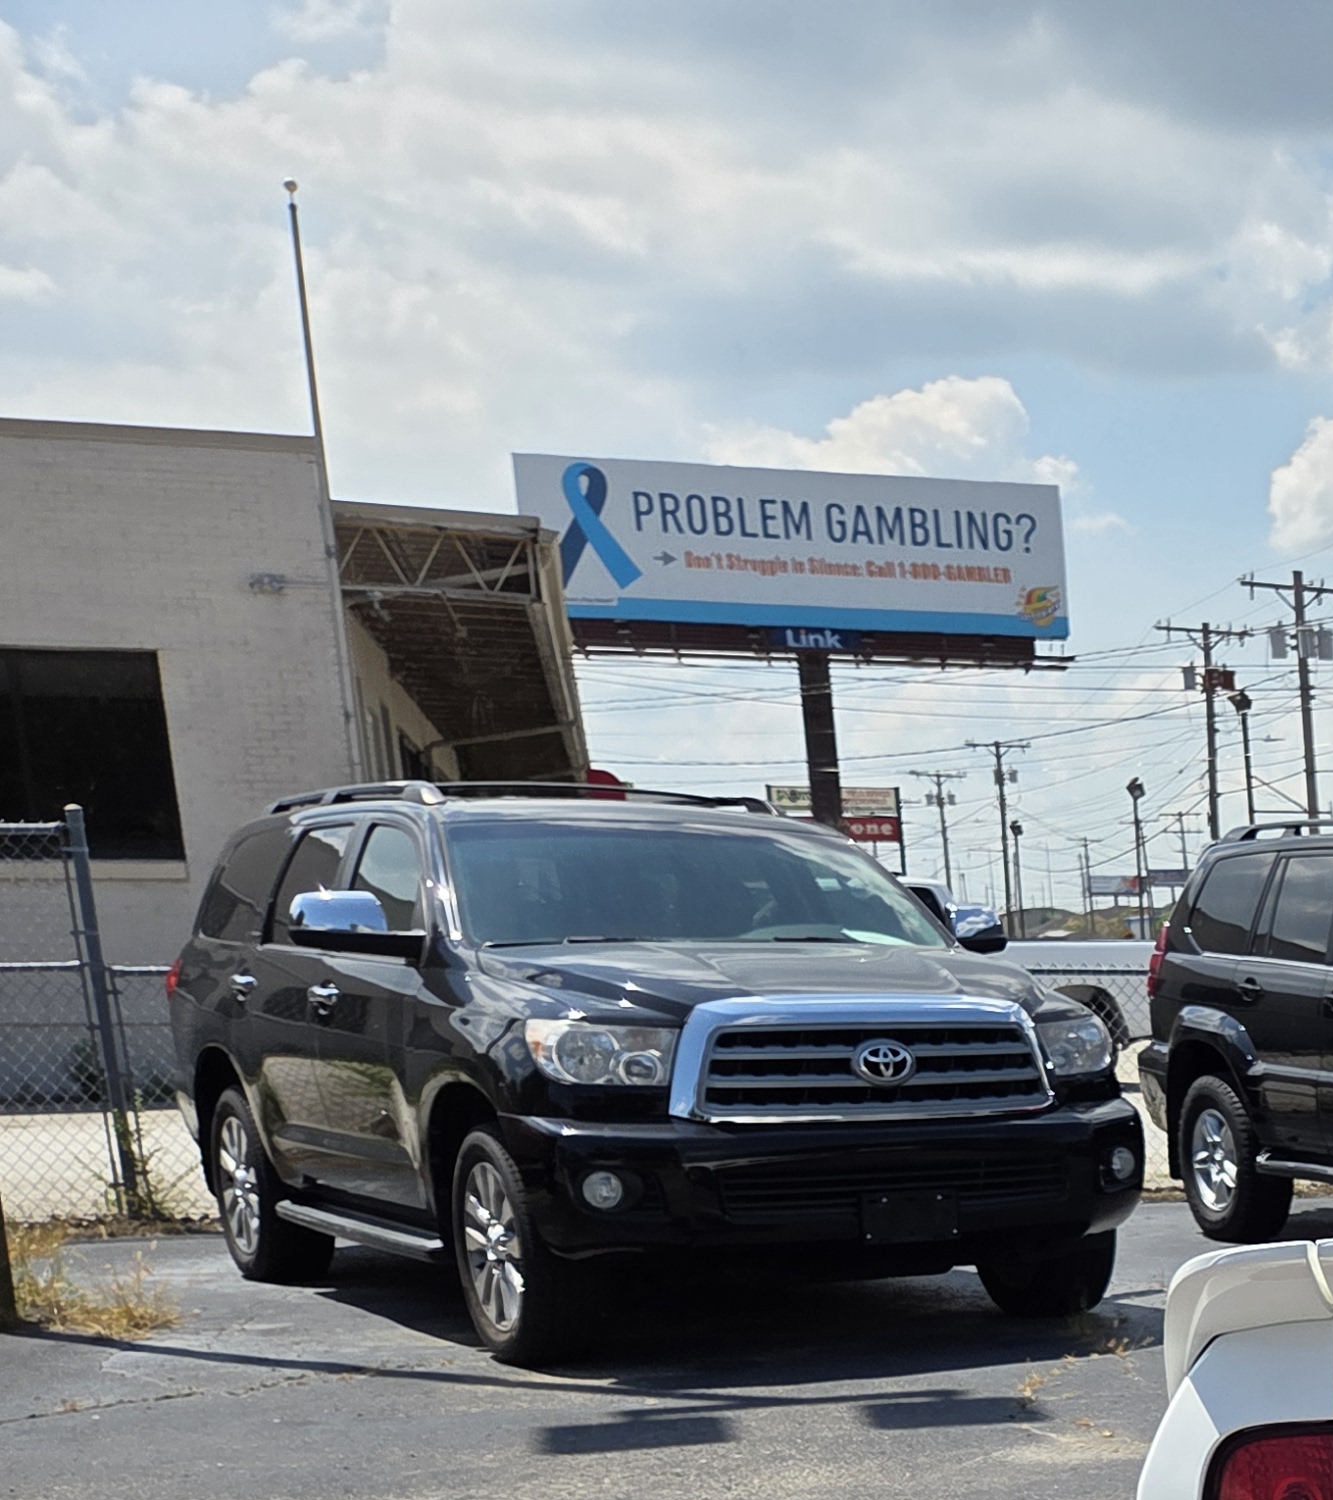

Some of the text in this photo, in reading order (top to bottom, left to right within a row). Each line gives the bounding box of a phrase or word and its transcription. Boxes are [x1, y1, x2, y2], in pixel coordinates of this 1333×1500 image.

[631, 490, 1037, 554] PROBLEM GAMBLING?
[785, 629, 843, 649] Link
